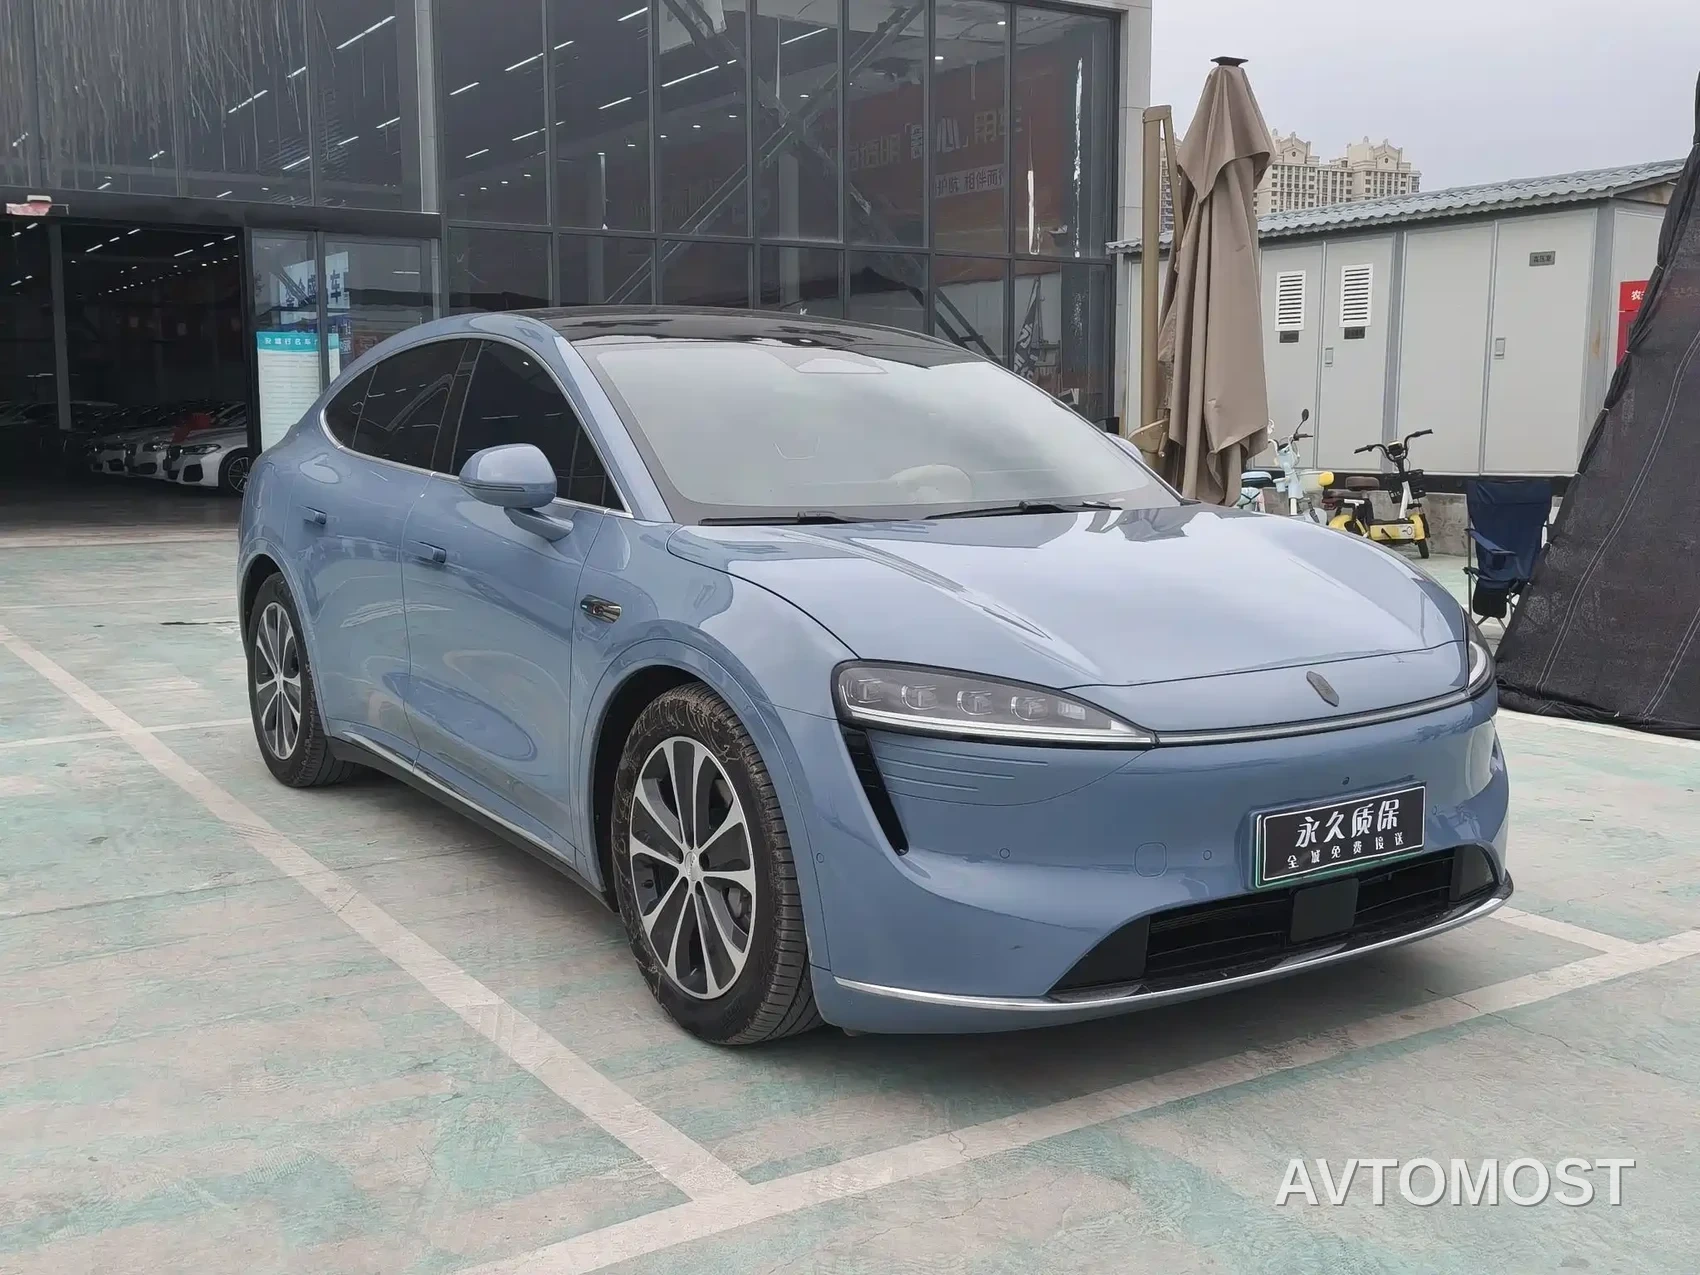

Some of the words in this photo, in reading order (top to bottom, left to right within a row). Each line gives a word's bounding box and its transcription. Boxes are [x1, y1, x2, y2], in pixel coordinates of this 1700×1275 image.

[1295, 799, 1400, 848] 永久质保
[1287, 831, 1404, 869] 全城免费接送
